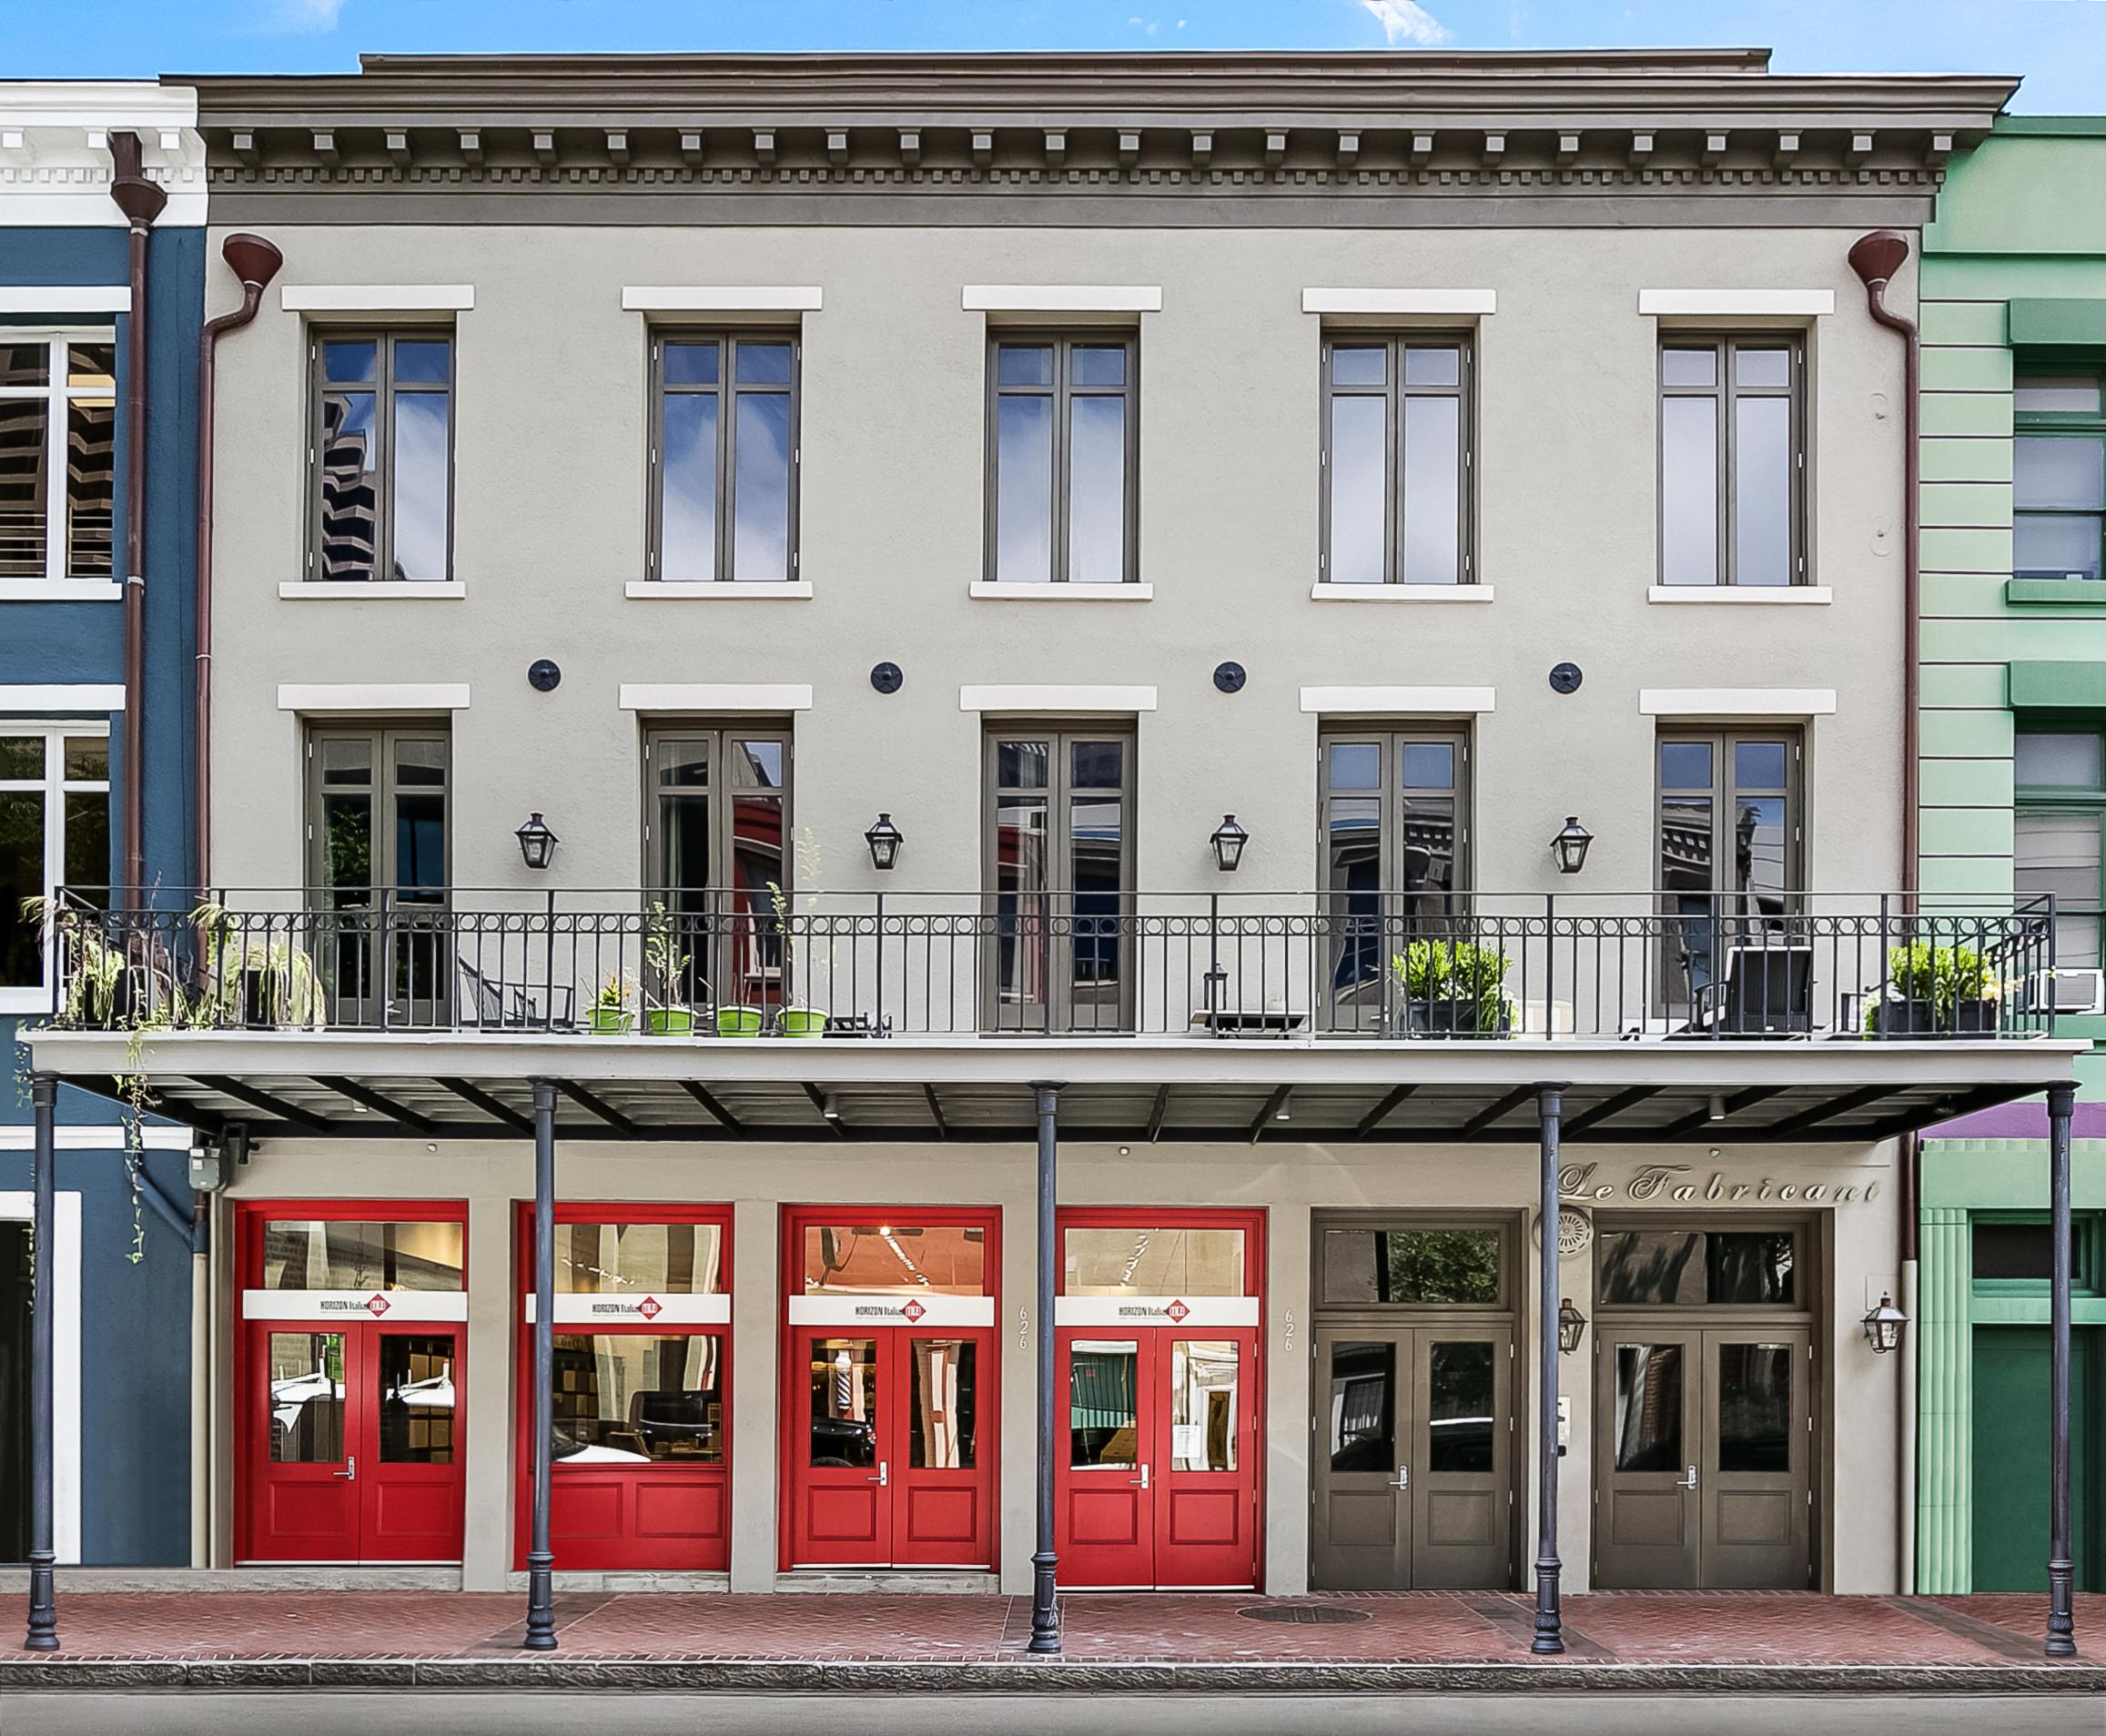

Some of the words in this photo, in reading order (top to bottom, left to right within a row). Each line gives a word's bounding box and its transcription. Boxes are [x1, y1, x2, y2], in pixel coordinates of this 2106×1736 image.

[1558, 1162, 1615, 1202] Le
[1627, 1164, 1881, 1202] Fabricant
[320, 1301, 348, 1310] HORIZON
[592, 1304, 620, 1313] HORIZON
[856, 1307, 883, 1316] HORIZON
[1119, 1307, 1147, 1316] HORIZON
[1019, 1306, 1028, 1349] 626
[1284, 1308, 1294, 1352] 626
